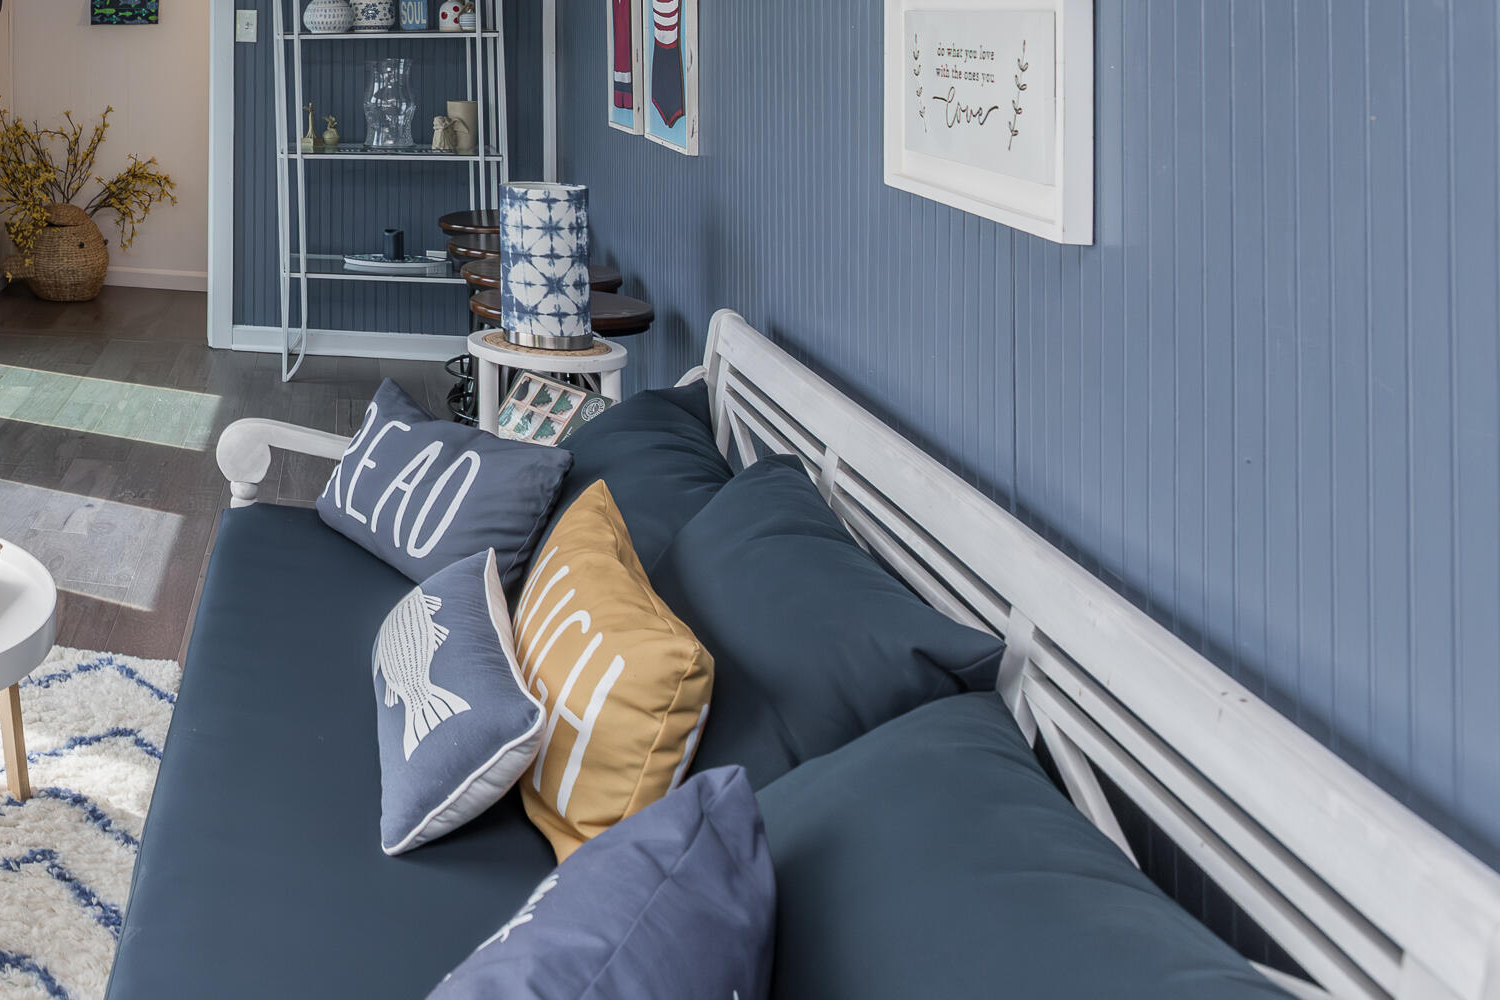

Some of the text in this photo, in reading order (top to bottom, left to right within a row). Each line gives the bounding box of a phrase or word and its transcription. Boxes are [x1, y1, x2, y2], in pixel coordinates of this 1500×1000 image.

[400, 1, 427, 25] SOUL
[937, 42, 994, 63] do what you love
[936, 64, 994, 87] with the ones you
